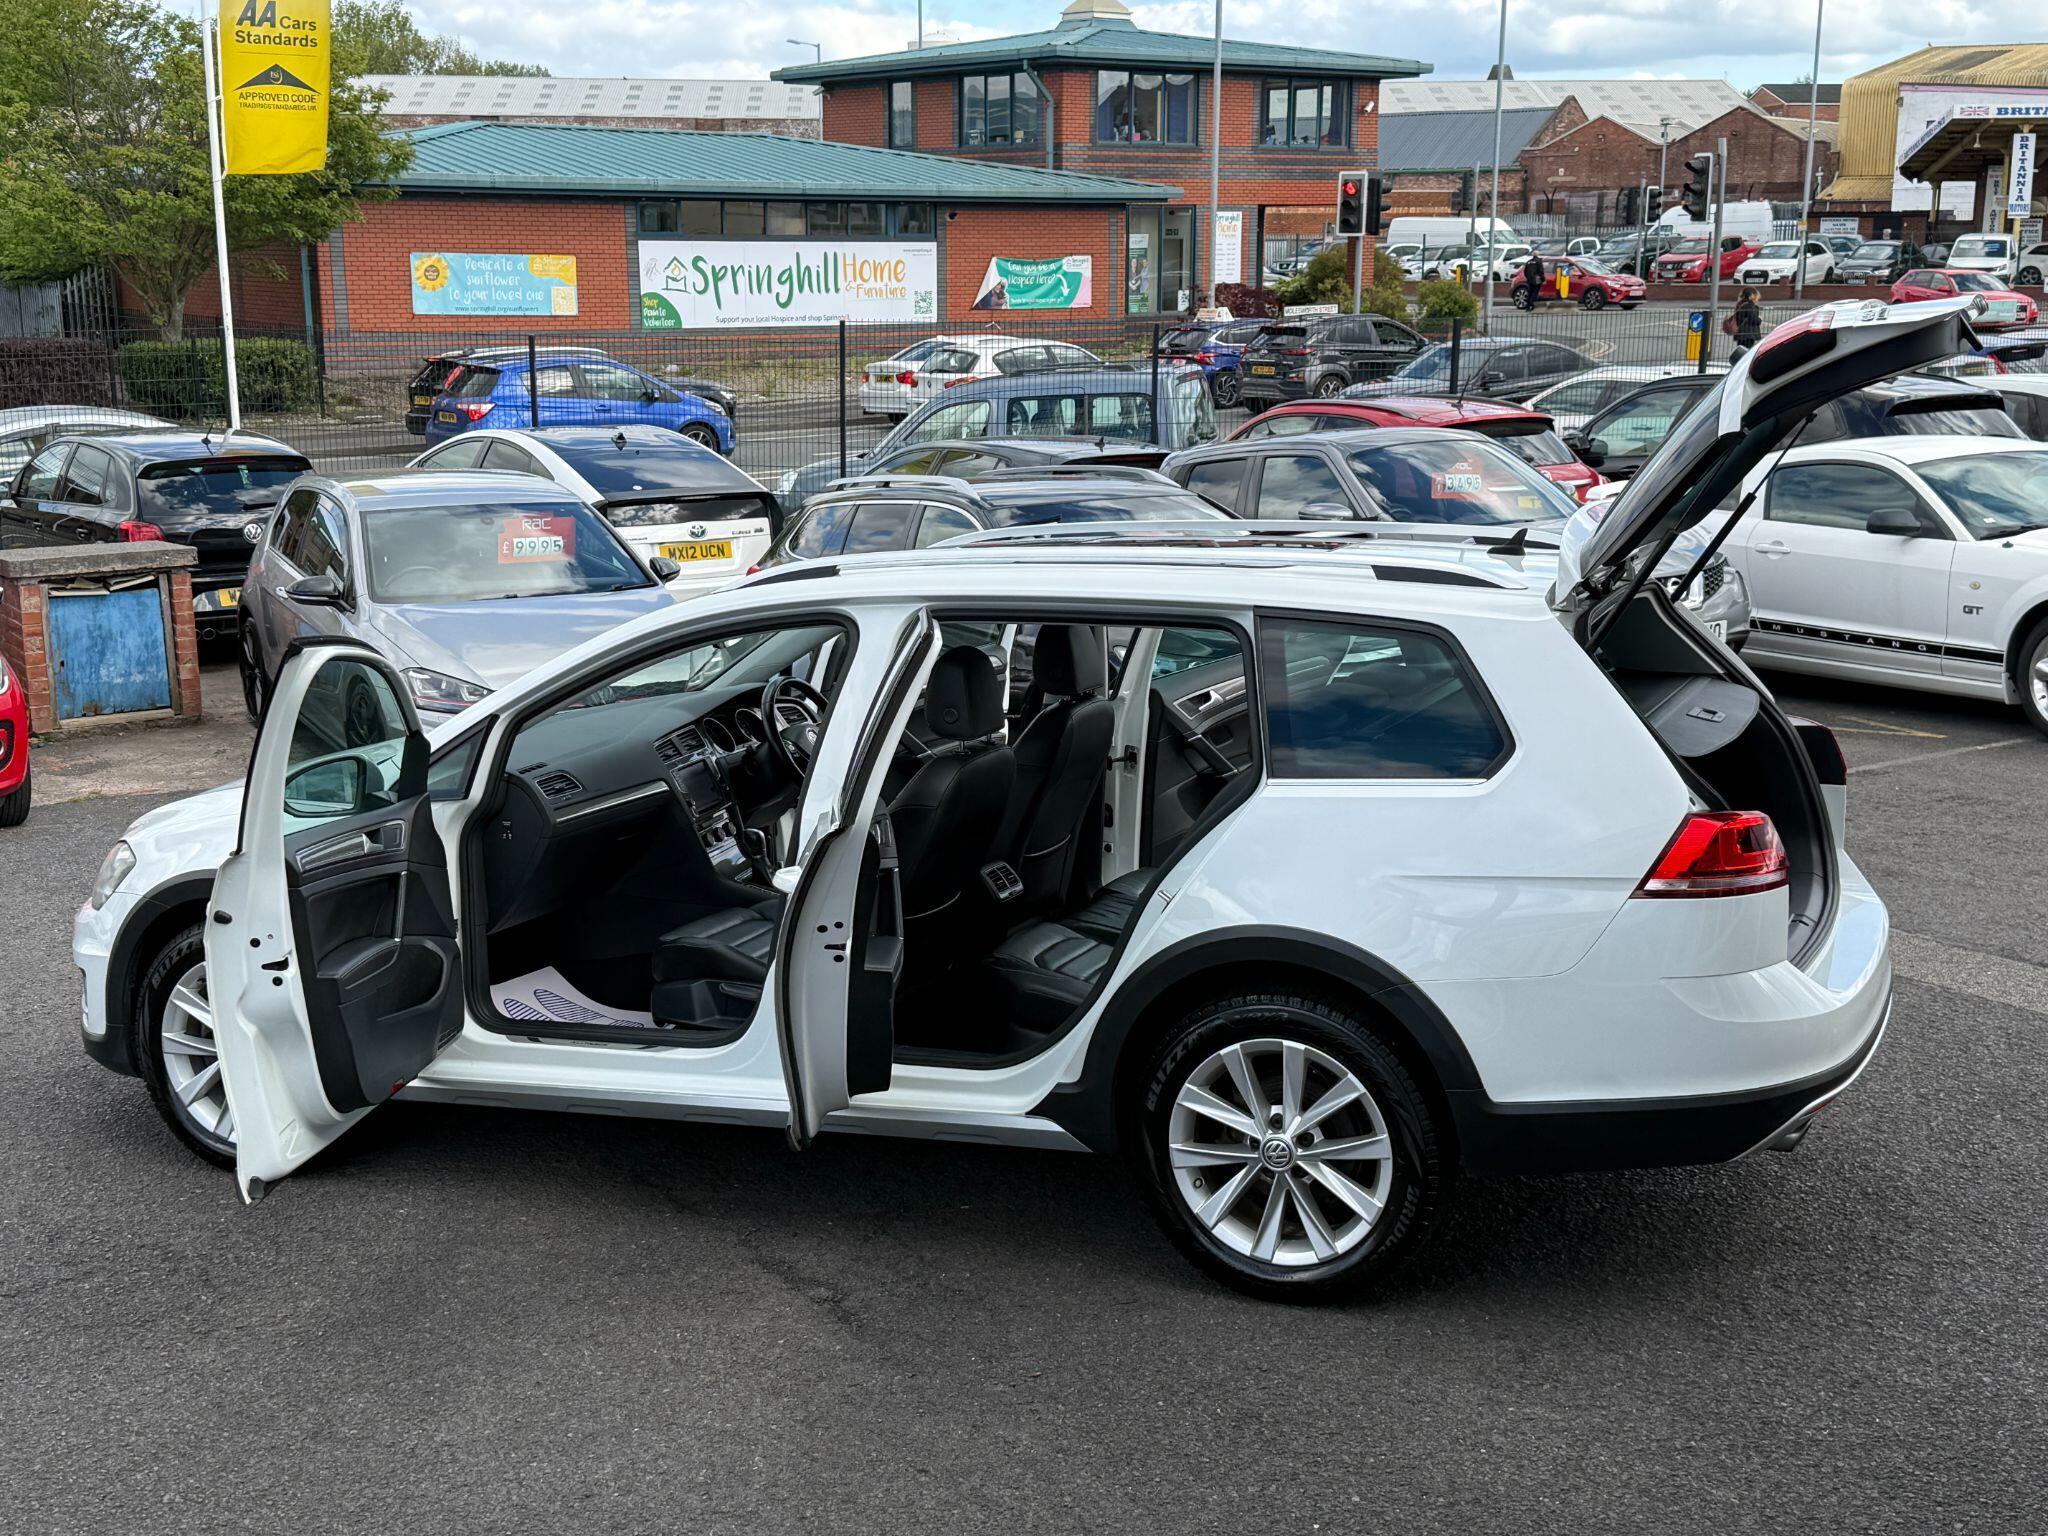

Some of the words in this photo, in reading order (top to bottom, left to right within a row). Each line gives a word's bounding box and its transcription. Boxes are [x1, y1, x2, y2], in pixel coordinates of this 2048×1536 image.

[236, 0, 277, 28] AA
[279, 16, 317, 31] Cars
[235, 30, 318, 48] Standards
[238, 91, 290, 103] APPROVED
[291, 94, 317, 104] CODE
[2015, 135, 2030, 202] BRITANNIA
[2008, 203, 2030, 212] MOTORS
[465, 257, 513, 272] Dedicate
[517, 262, 525, 272] a
[467, 271, 521, 287] sunflower
[691, 251, 841, 310] Springhill
[842, 252, 906, 284] Home
[1008, 274, 1035, 288] Hospice
[1036, 273, 1056, 285] Hero?
[464, 290, 489, 305] your
[492, 287, 523, 301] loved
[526, 290, 545, 302] one
[856, 283, 907, 300] Furniture
[715, 315, 739, 324] Support
[740, 316, 755, 324] your
[756, 314, 770, 323] local
[771, 314, 794, 323] Hospice
[795, 313, 807, 321] and
[808, 314, 823, 323] shop
[668, 545, 697, 560] MX12
[701, 543, 725, 558] UCN
[1962, 604, 1984, 616] GT
[1772, 623, 1928, 652] MUSTANG
